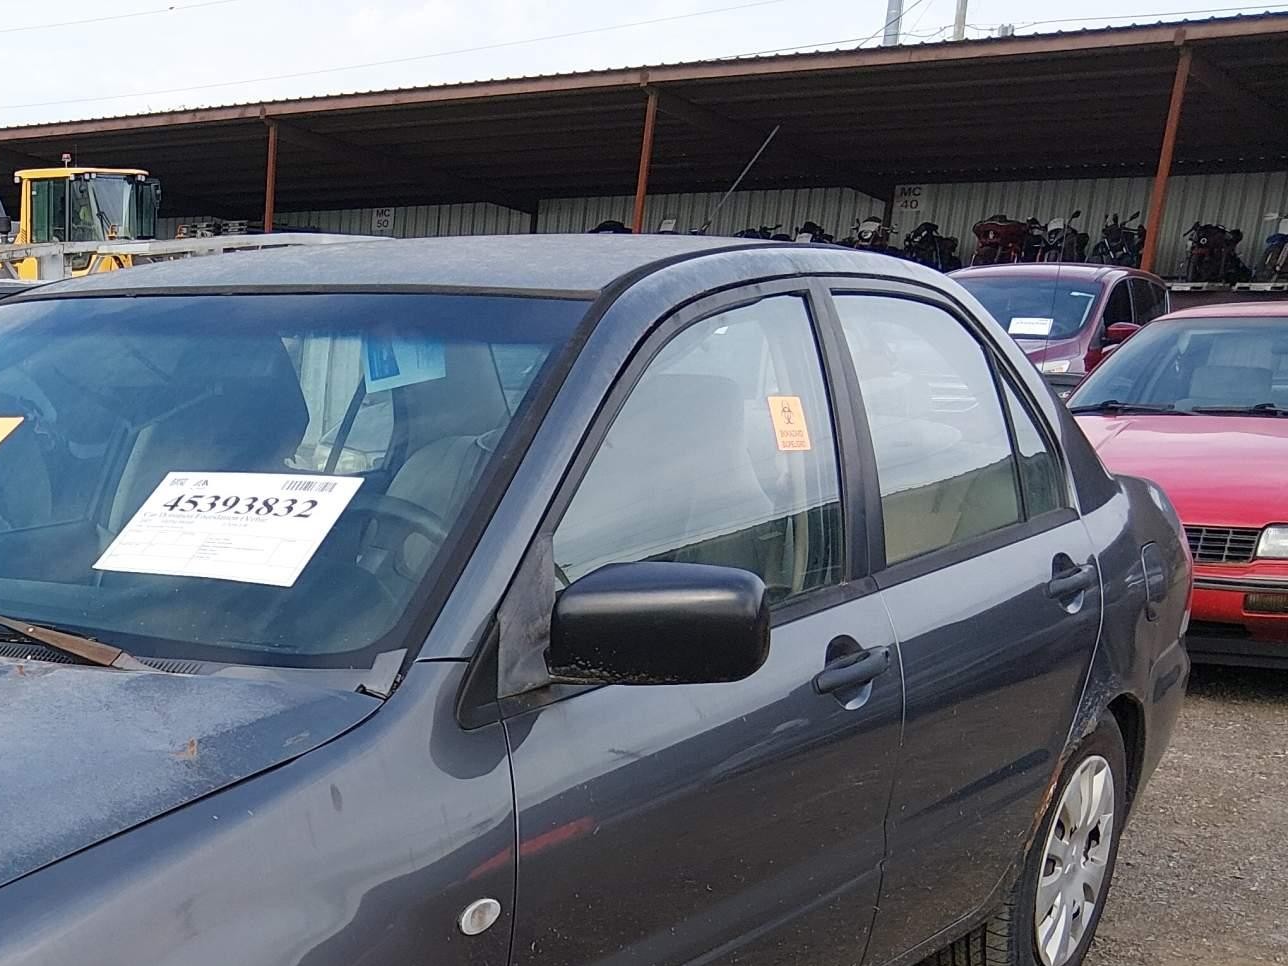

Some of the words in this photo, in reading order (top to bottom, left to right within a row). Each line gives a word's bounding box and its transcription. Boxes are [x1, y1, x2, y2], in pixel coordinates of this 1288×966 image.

[900, 187, 921, 197] MC
[900, 199, 919, 209] 40
[377, 209, 390, 218] MC
[377, 219, 389, 227] 50
[163, 494, 318, 518] 45393832
